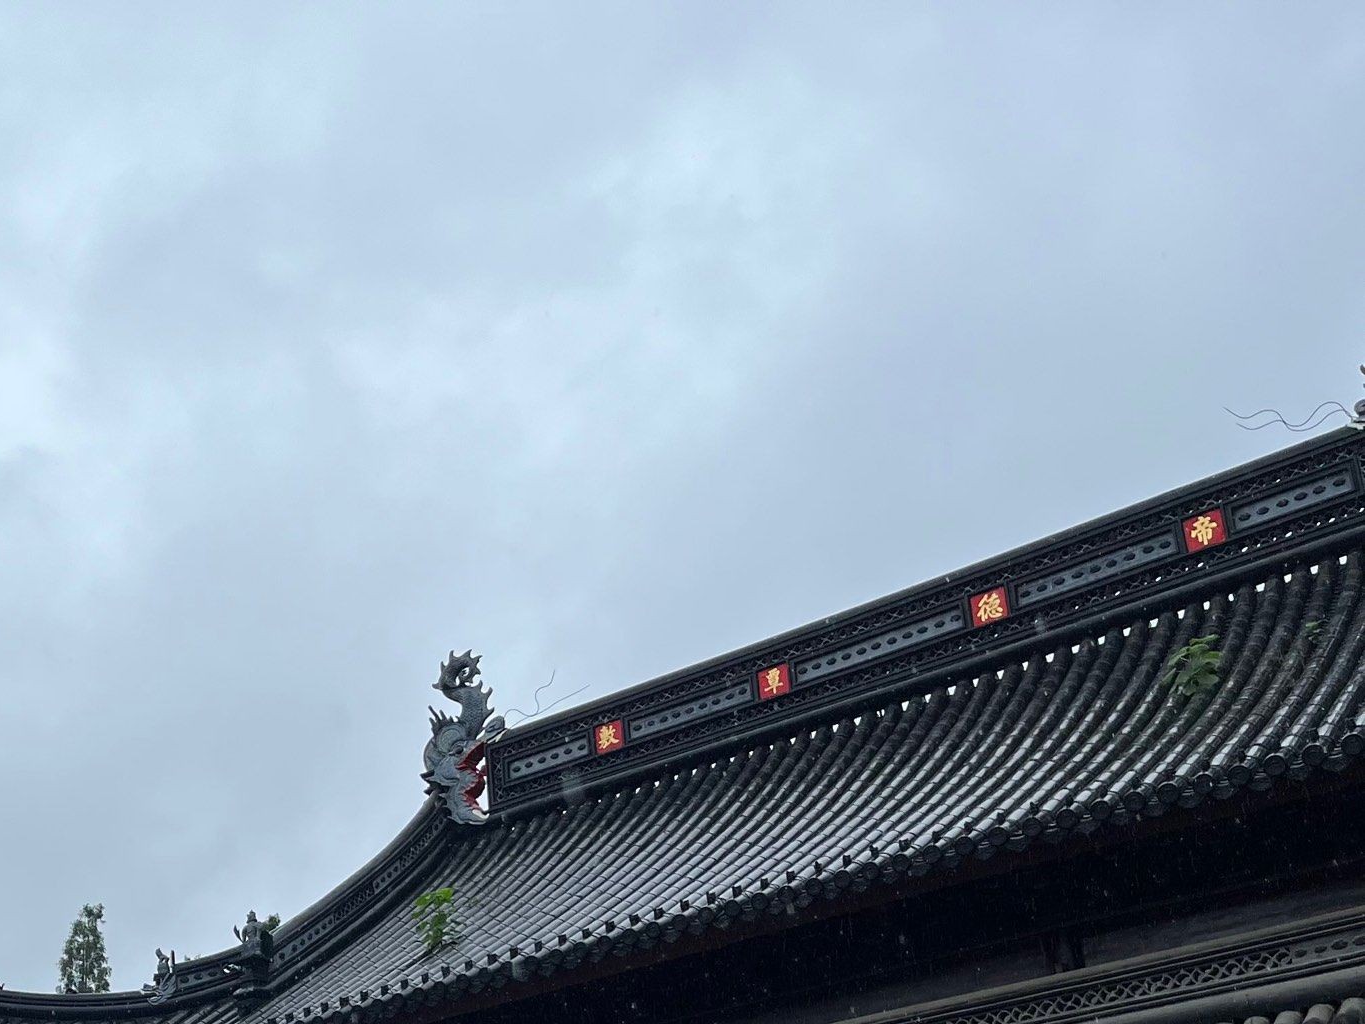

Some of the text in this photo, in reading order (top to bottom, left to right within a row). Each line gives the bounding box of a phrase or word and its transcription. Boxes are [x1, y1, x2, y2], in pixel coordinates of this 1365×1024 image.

[598, 515, 1218, 749] 帝 德 覃 敷
